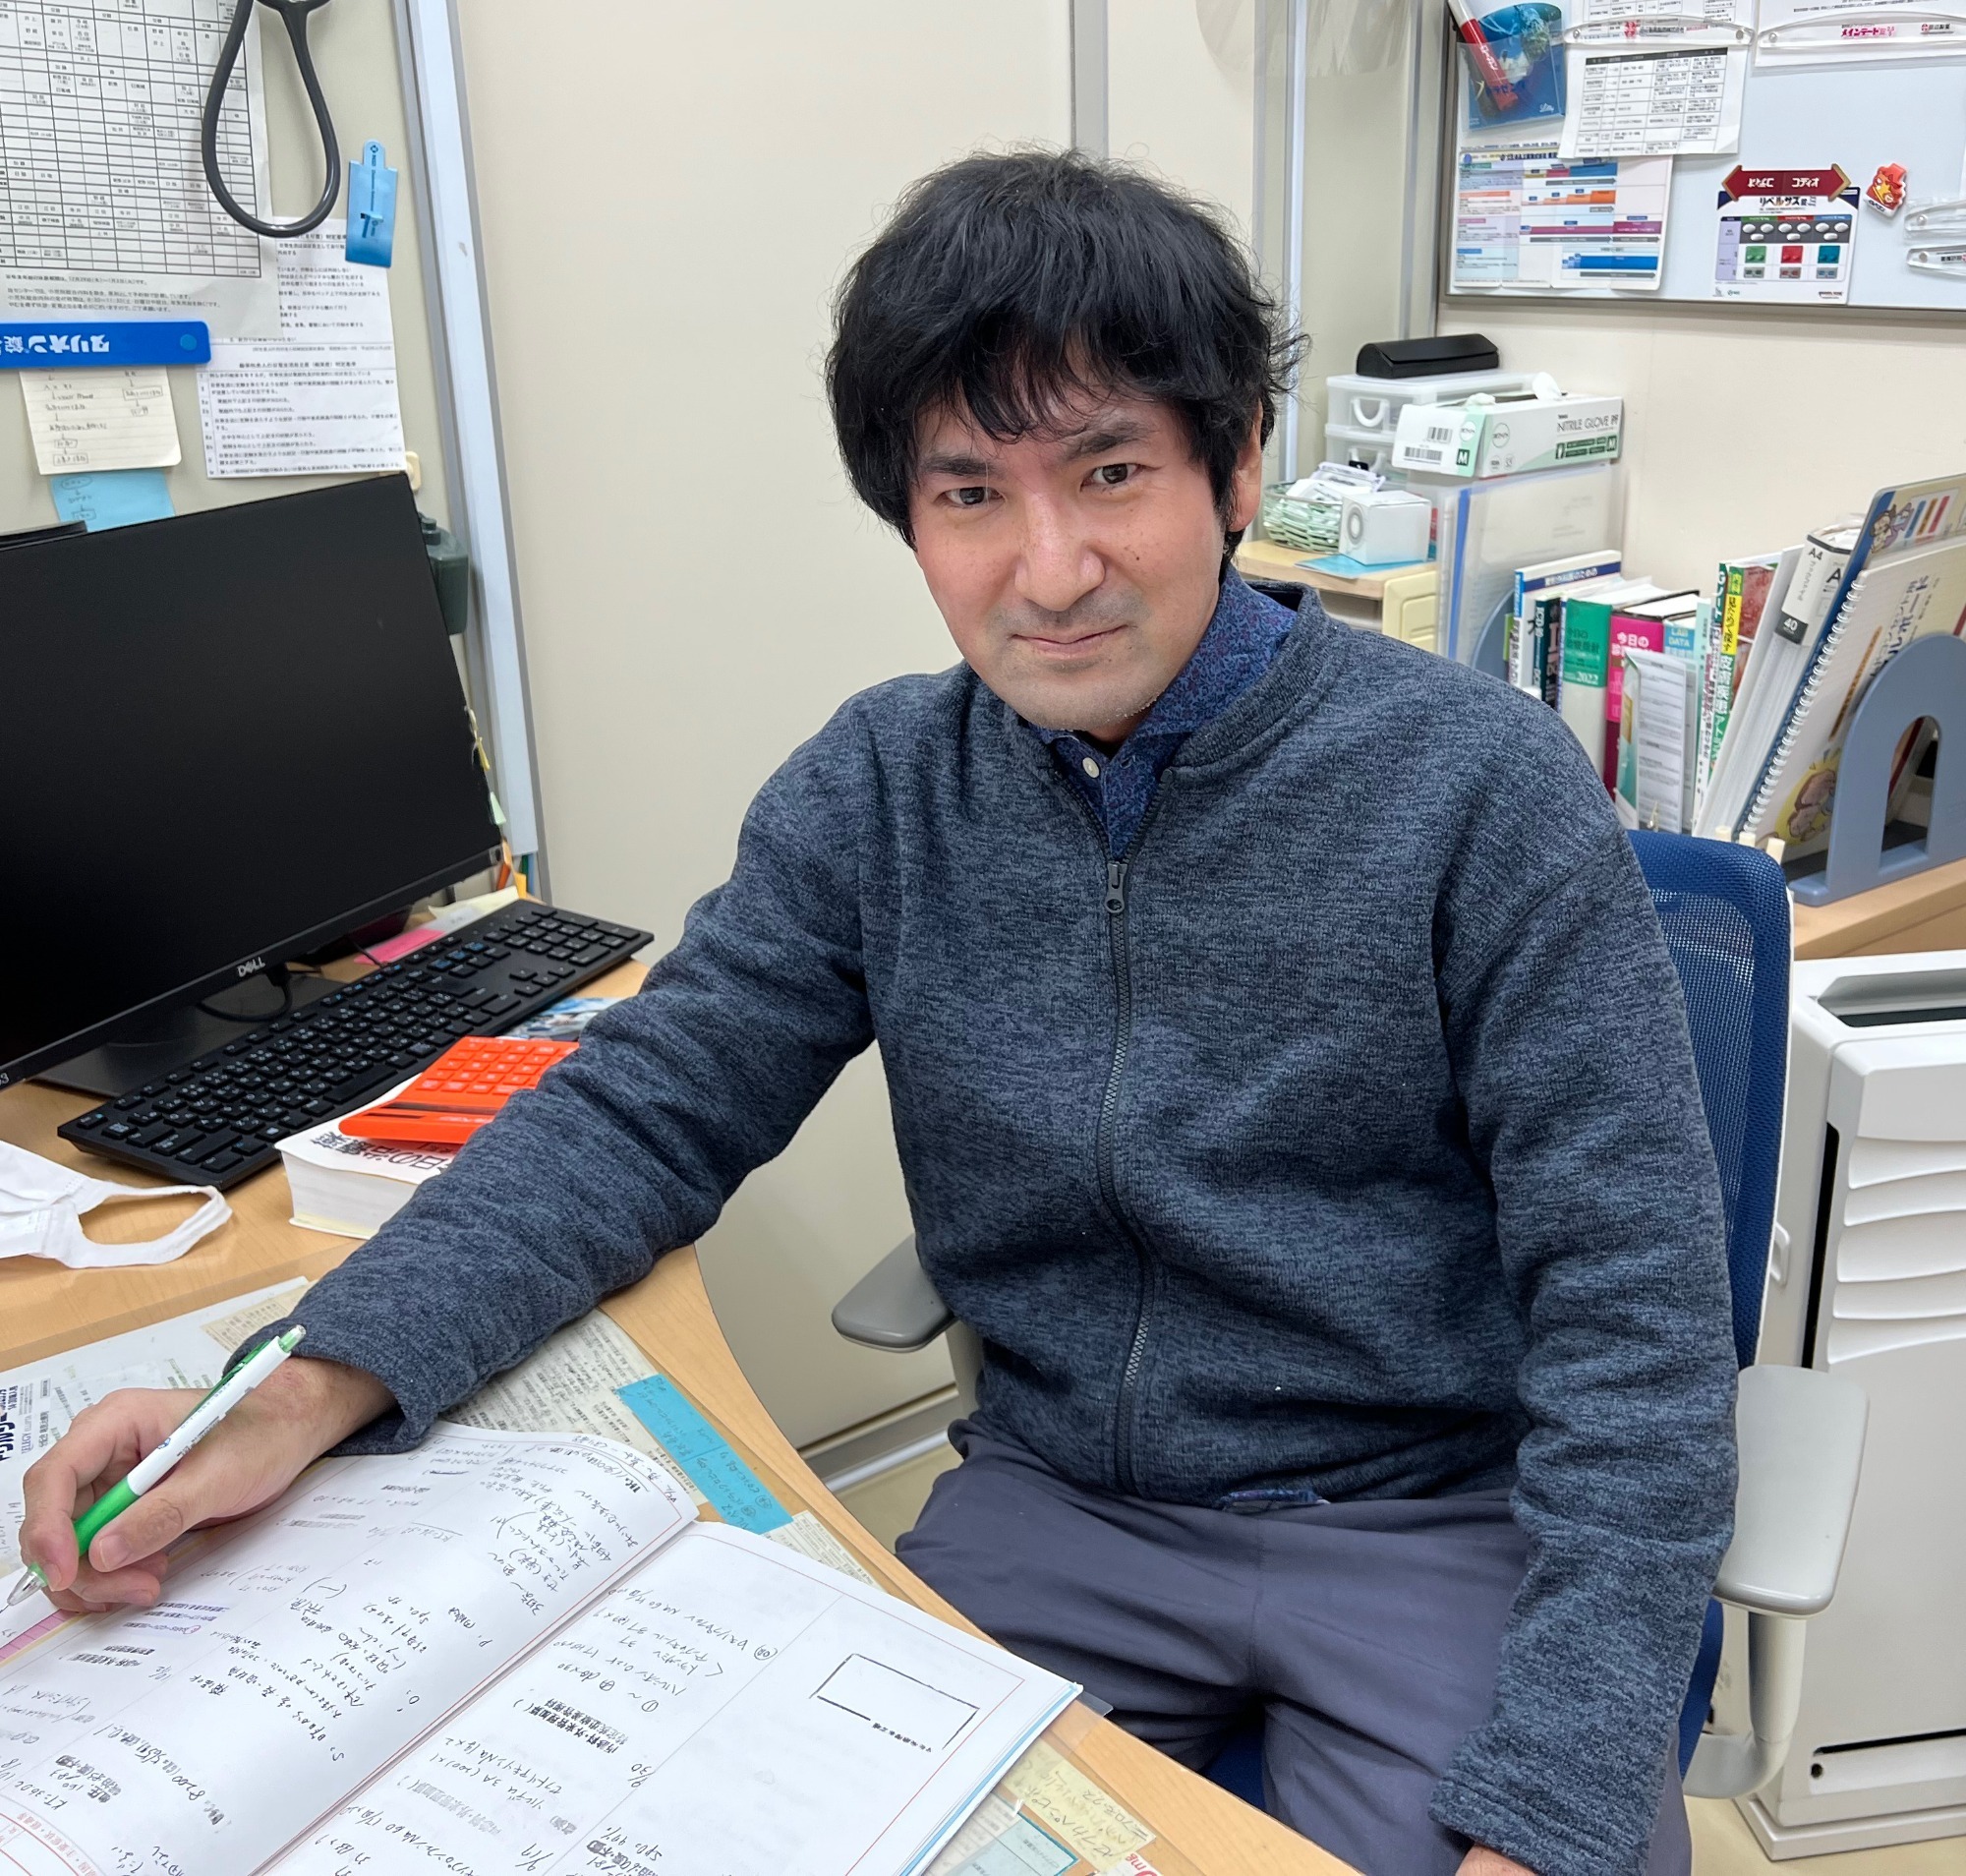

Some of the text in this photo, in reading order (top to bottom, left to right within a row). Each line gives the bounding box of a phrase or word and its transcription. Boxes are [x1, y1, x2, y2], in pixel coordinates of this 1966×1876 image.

[1557, 420, 1583, 433] NITRILE
[1584, 415, 1609, 429] GLOVE
[1458, 452, 1469, 465] M
[1809, 548, 1823, 560] A4
[1783, 617, 1798, 631] 40
[1617, 631, 1649, 649] 今日の
[1577, 671, 1599, 685] 2022
[237, 957, 266, 977] DELL
